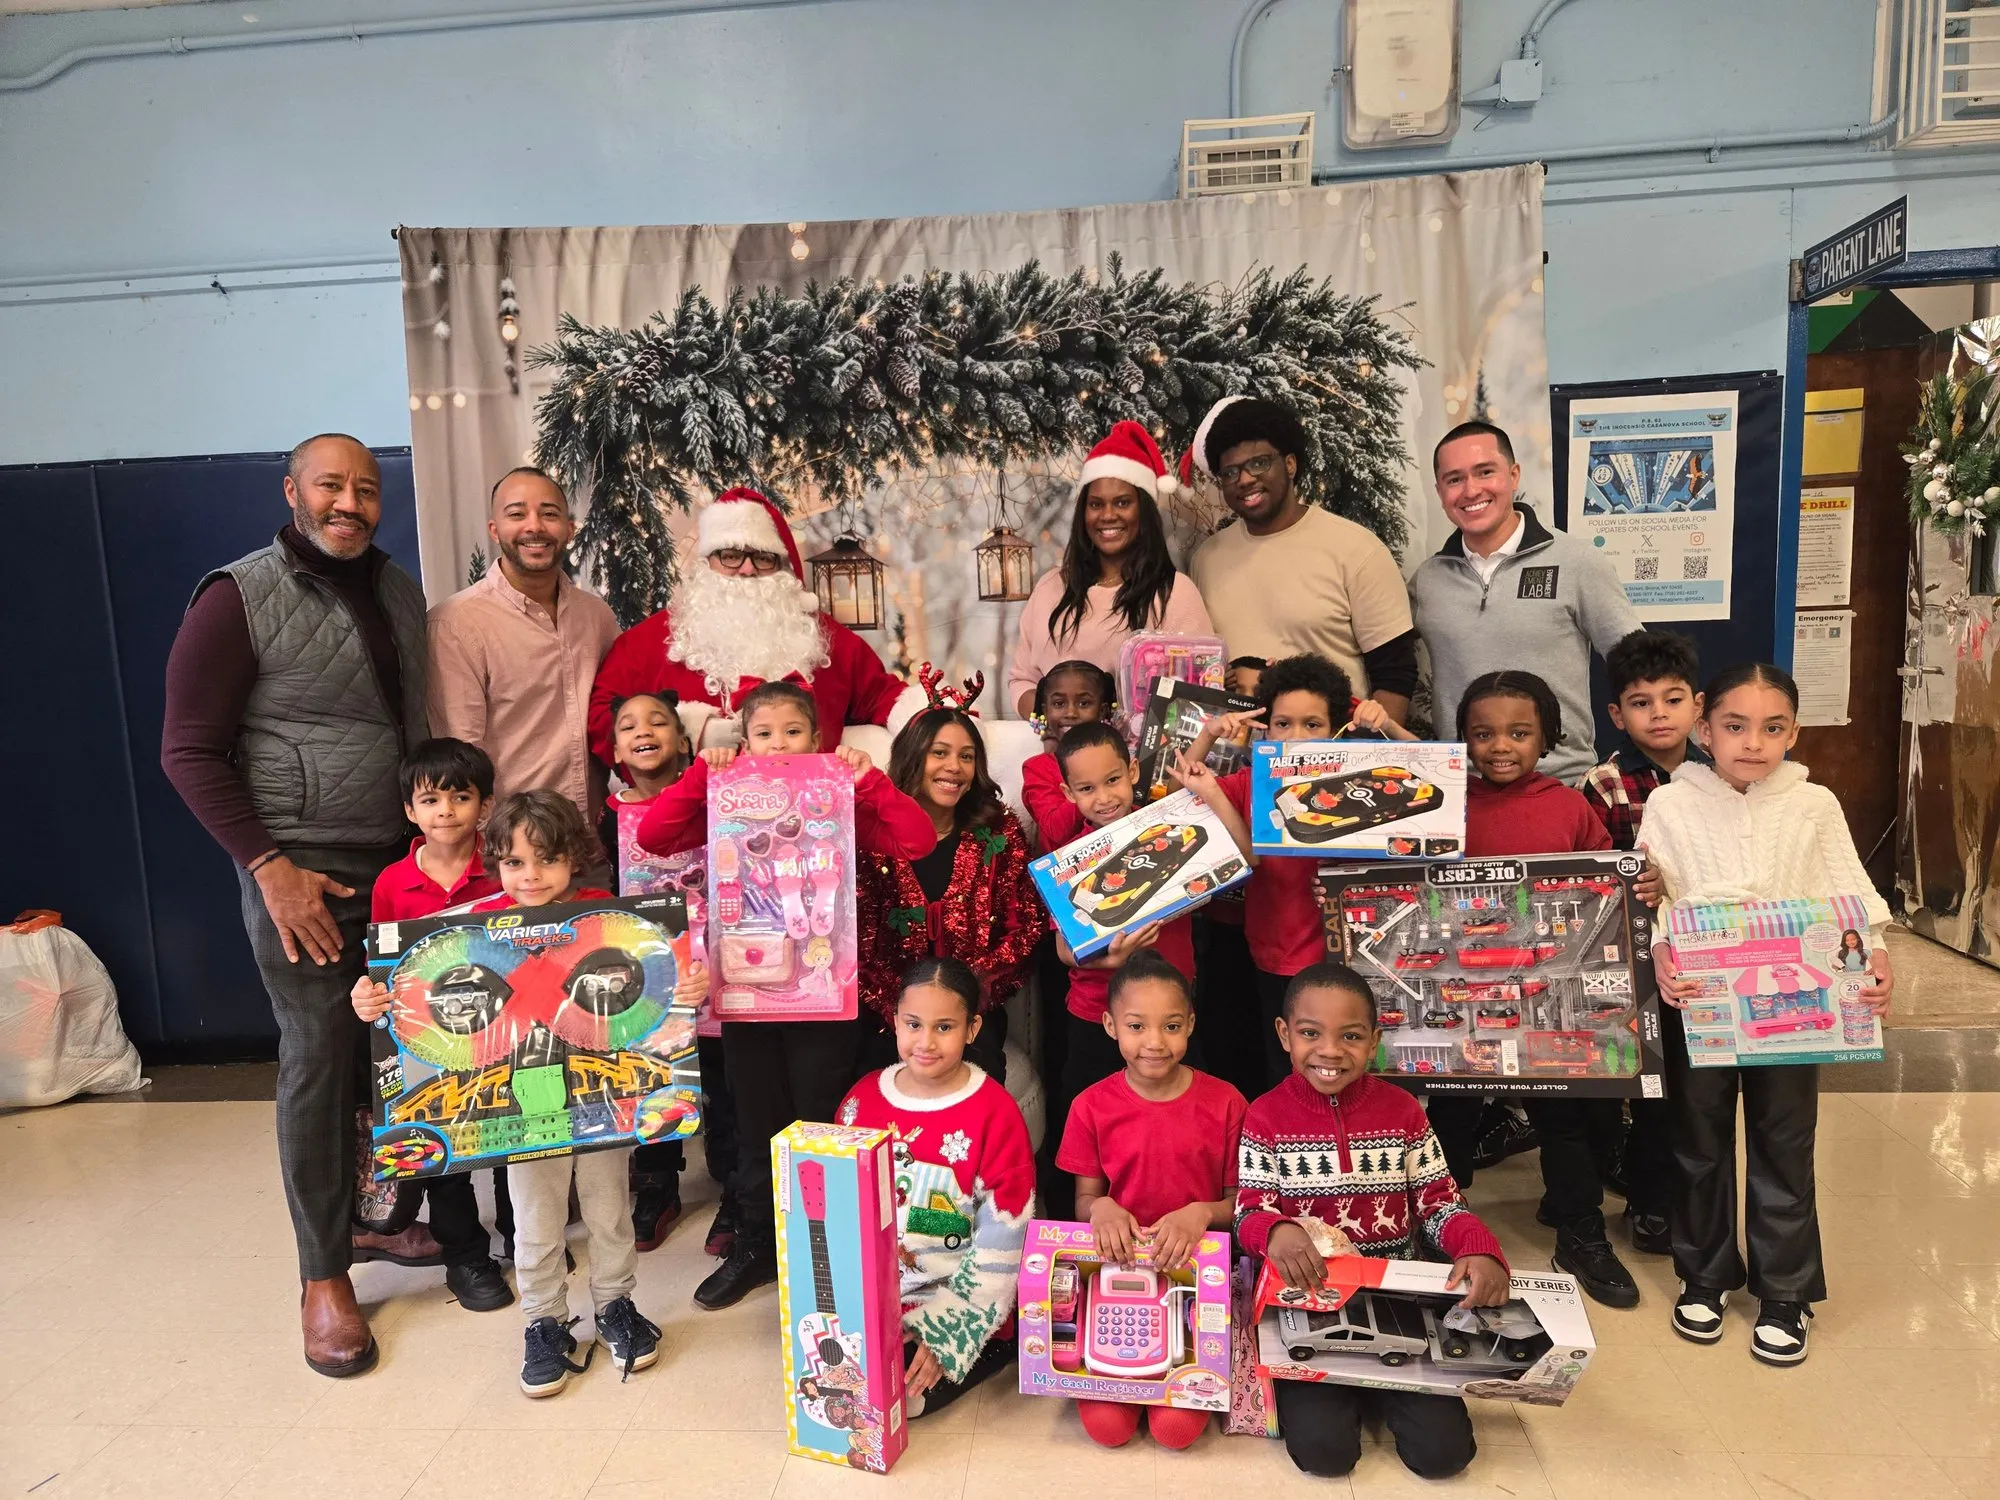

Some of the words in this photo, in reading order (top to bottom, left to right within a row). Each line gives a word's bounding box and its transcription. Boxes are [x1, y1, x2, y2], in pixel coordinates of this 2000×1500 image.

[1821, 231, 1865, 288] PARENT
[1868, 211, 1902, 265] LANE
[1810, 500, 1848, 510] DRILL
[1588, 519, 1616, 527] FOLLOW
[1641, 517, 1668, 525] SOCIAL
[1596, 526, 1627, 534] UPDATES
[1522, 584, 1543, 598] LAB
[1227, 698, 1255, 709] COLLECT
[1449, 748, 1460, 756] 3+
[1268, 755, 1301, 769] TABLE
[1303, 751, 1348, 765] SOCCER
[1270, 767, 1296, 779] AND
[1297, 763, 1343, 776] HOCKEY
[1048, 854, 1077, 878] TABLE
[1075, 833, 1113, 861] SOCCER
[1056, 867, 1077, 886] AND
[1076, 843, 1112, 873] HOCKEY
[670, 896, 681, 904] 3+
[486, 915, 523, 930] LED
[1324, 898, 1341, 953] CAR
[488, 922, 565, 941] VARIETY
[513, 933, 572, 947] TRACKS
[1681, 960, 1719, 968] magic
[1846, 984, 1860, 992] 20
[1850, 1052, 1882, 1060] PCS/PZS
[377, 1066, 403, 1086] 178
[780, 1146, 788, 1174] GUITAR
[1038, 1225, 1069, 1242] My
[1072, 1230, 1094, 1242] Ca
[1511, 1279, 1530, 1288] DIY
[1534, 1281, 1571, 1292] SERIES
[1270, 1367, 1316, 1377] VEHICLE
[1032, 1372, 1055, 1386] My
[1060, 1378, 1091, 1390] Cash
[1096, 1380, 1156, 1395] Register
[1380, 1382, 1421, 1391] PLAYSET
[866, 1425, 886, 1472] Barbie
